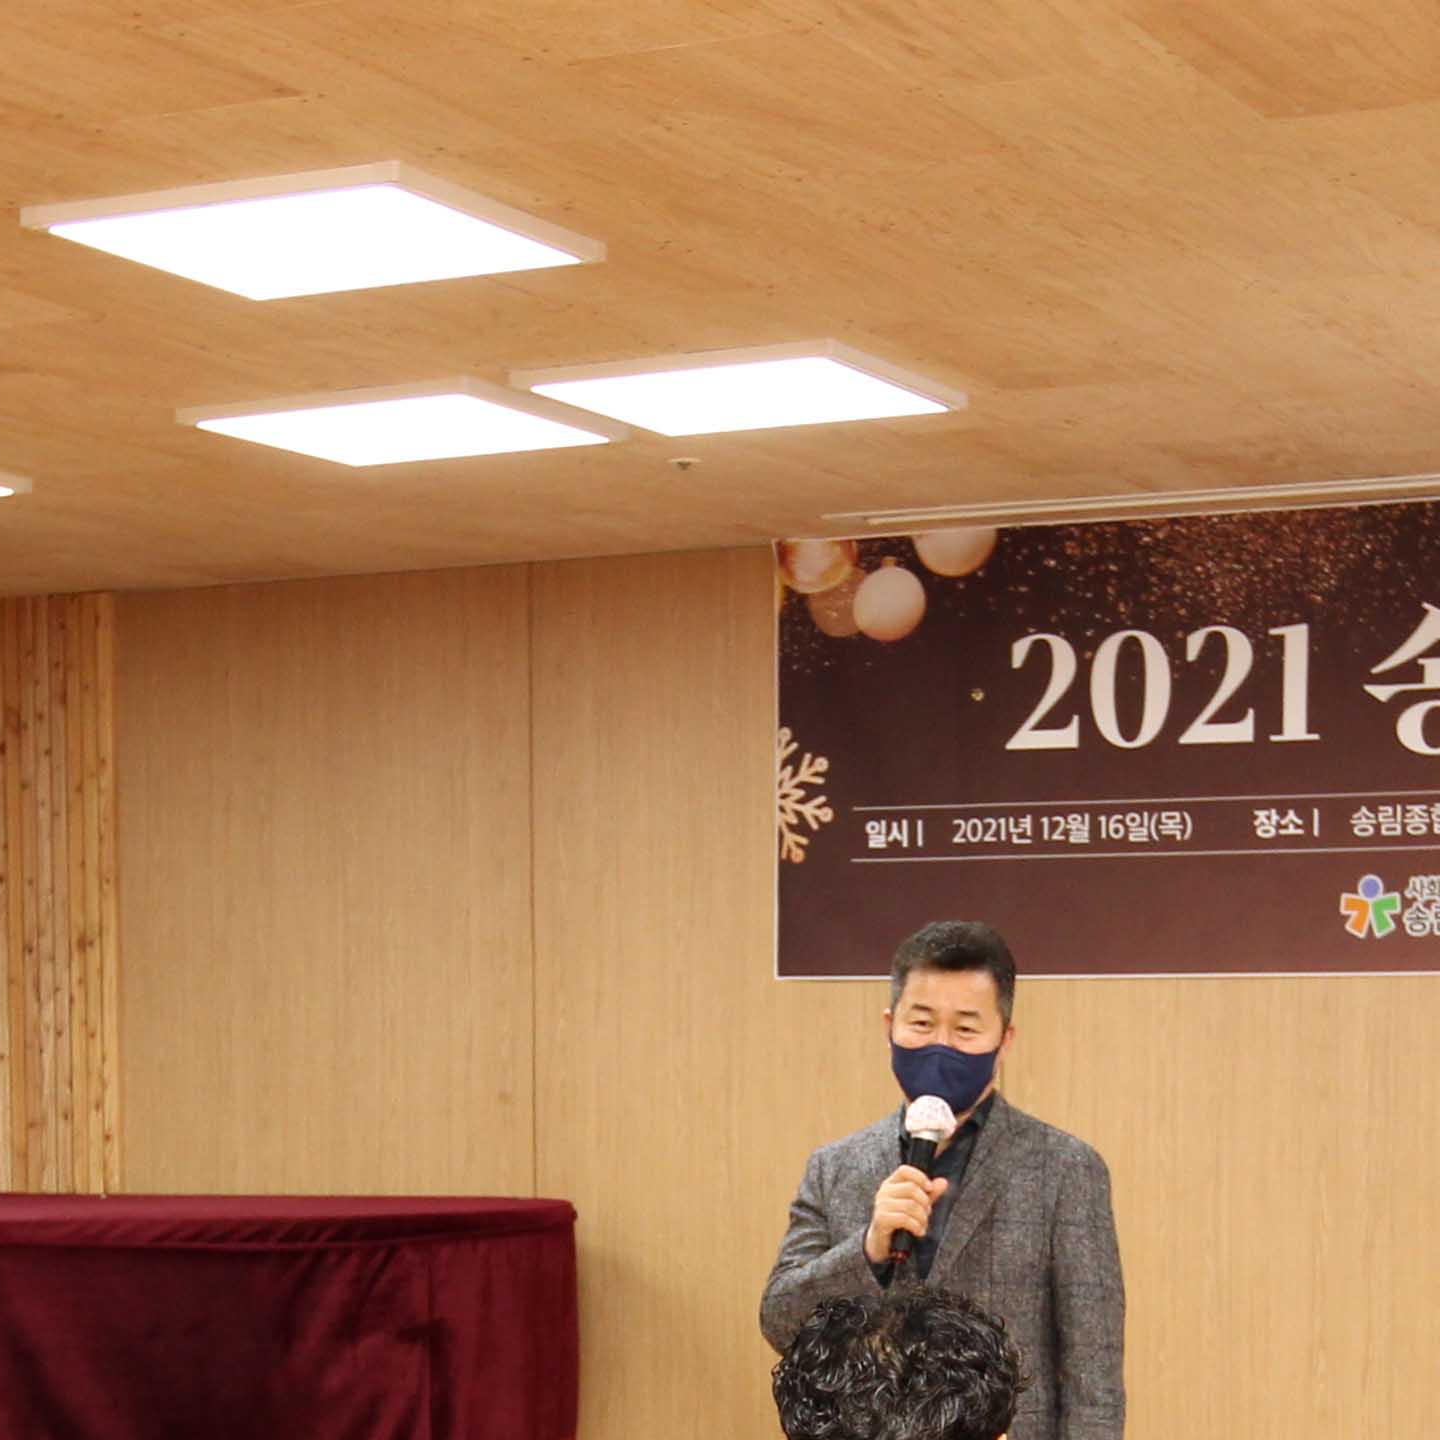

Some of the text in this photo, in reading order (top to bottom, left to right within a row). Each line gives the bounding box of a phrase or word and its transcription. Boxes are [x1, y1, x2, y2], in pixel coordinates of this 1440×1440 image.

[1005, 623, 1320, 750] 2021
[865, 819, 909, 848] 일시
[952, 815, 1033, 843] 2021년
[1041, 813, 1090, 843] 12월
[1098, 810, 1193, 842] 16일(목)
[1253, 808, 1305, 838] 장소
